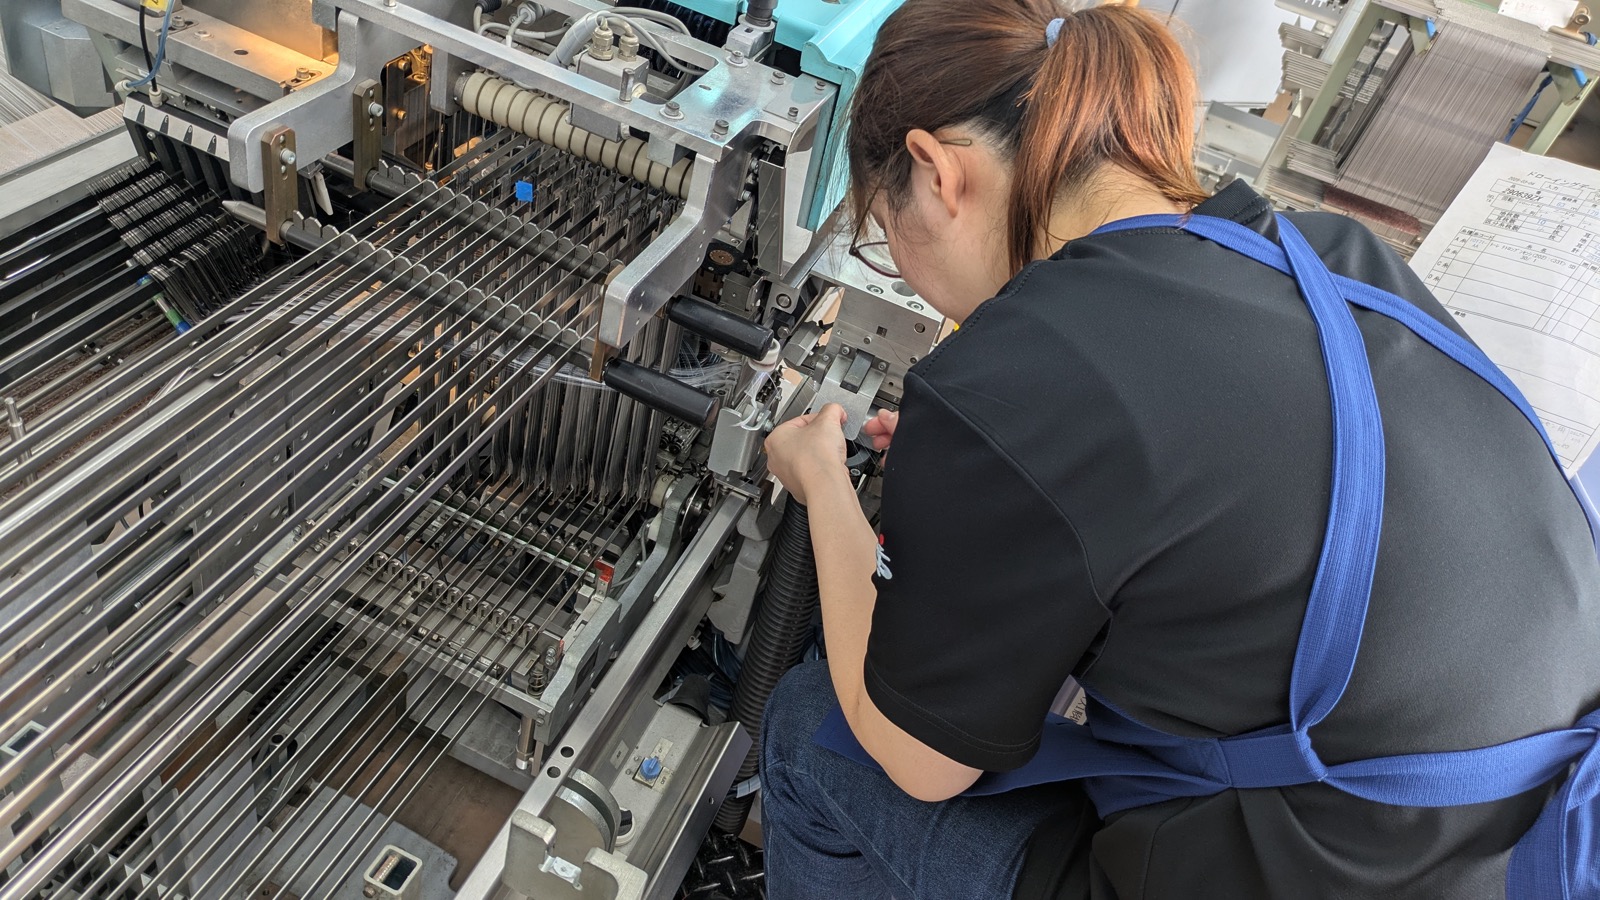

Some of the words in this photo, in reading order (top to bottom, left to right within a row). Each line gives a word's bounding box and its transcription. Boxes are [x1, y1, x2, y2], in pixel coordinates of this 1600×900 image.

[1528, 172, 1600, 192] ドローイングデー
